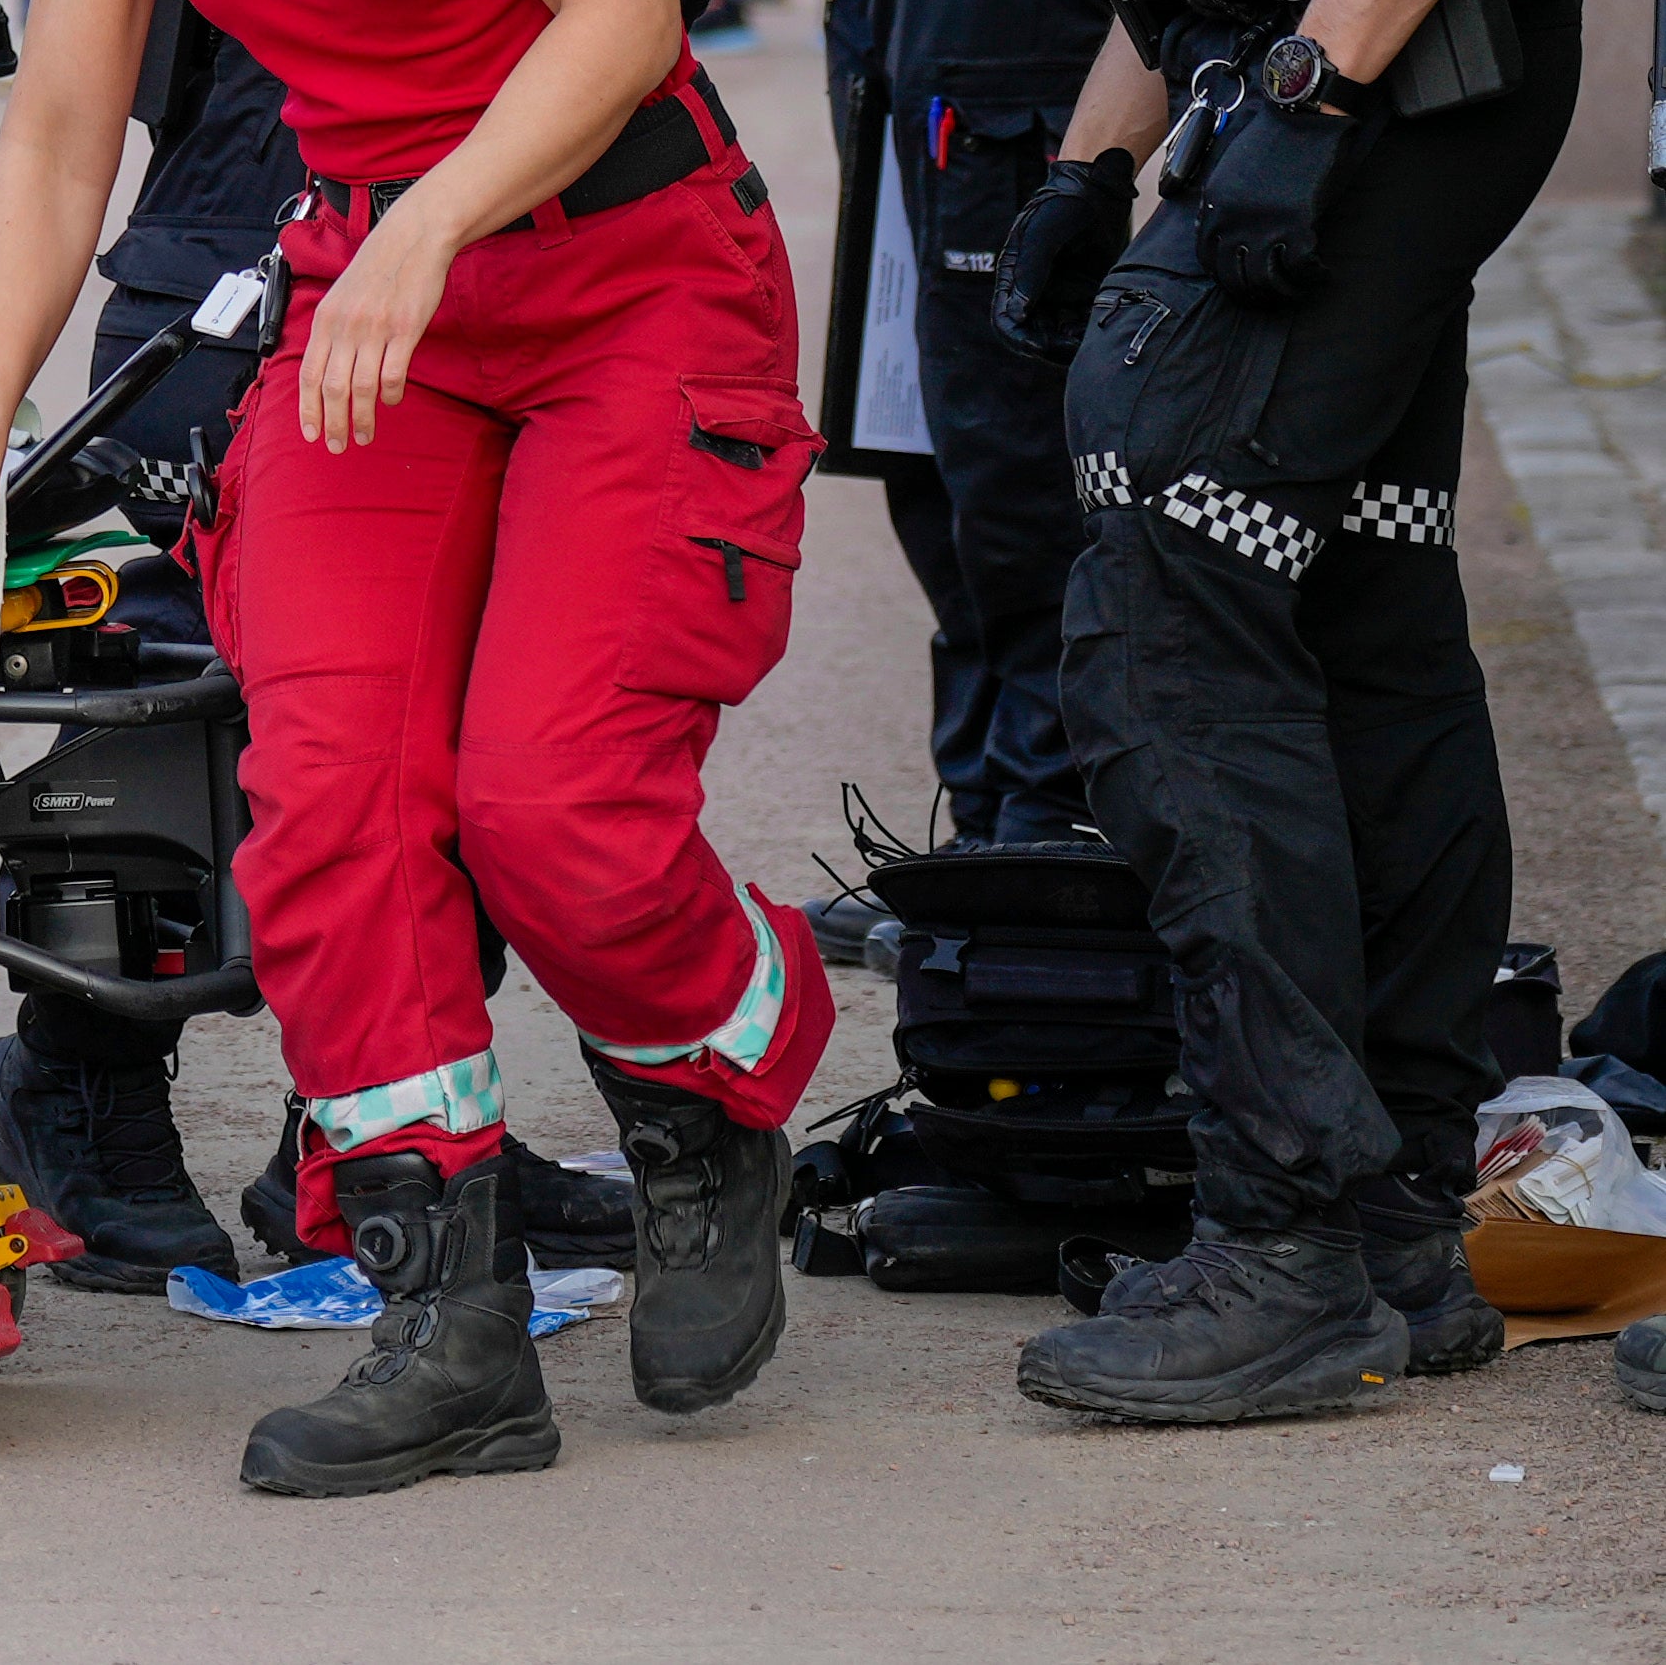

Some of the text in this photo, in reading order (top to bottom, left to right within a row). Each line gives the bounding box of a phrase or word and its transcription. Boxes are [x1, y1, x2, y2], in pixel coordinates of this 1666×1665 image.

[969, 252, 997, 272] 112
[41, 796, 116, 808] SMRT Power
